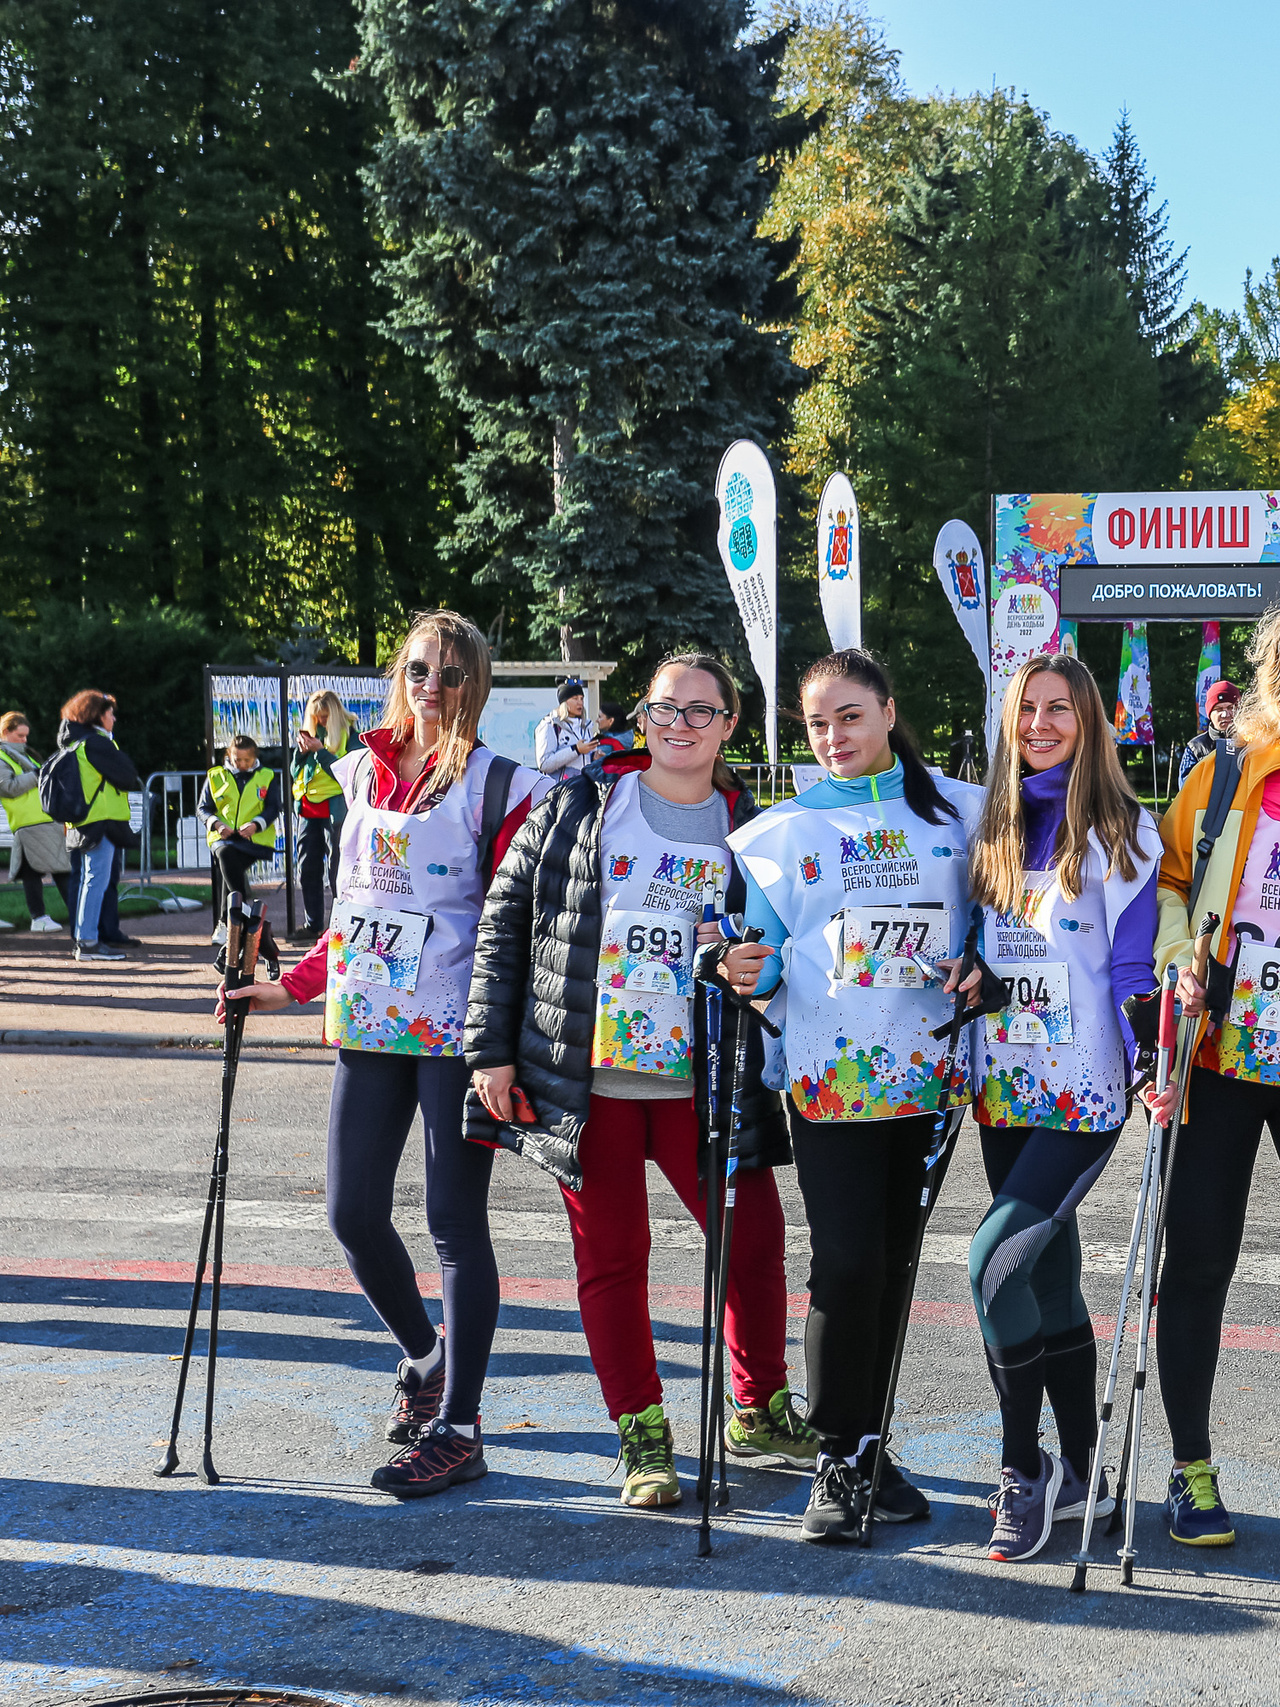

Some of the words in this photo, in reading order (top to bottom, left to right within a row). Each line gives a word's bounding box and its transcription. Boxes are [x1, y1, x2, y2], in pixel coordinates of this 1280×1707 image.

[1107, 505, 1250, 550] ФИНИШ
[743, 579, 759, 623] КУЛЬТУРЕ
[750, 575, 770, 639] ФИЗИЧЕСКОЙ
[757, 572, 771, 615] КОМИТЕТ
[767, 616, 774, 632] ПО
[1091, 583, 1145, 602] ДОБРО
[1149, 582, 1262, 600] ПОЖАЛОВАТЬ!
[739, 592, 753, 628] СПОРТУ
[1006, 621, 1021, 629] ДЕНЬ
[1022, 620, 1045, 628] ХОДЬБЫ
[841, 859, 919, 878] ВСЕРОССИЙСКИЙ
[843, 873, 873, 893] ДЕНЬ
[875, 871, 920, 890] ХОДЬБЫ
[641, 893, 671, 912] ДЕНЬ
[350, 916, 403, 952] 717
[627, 924, 683, 958] 693
[870, 920, 930, 951] 777
[997, 943, 1013, 958] ДЕНЬ
[1014, 943, 1047, 959] ХОДЬБЫ
[1000, 976, 1051, 1007] 704
